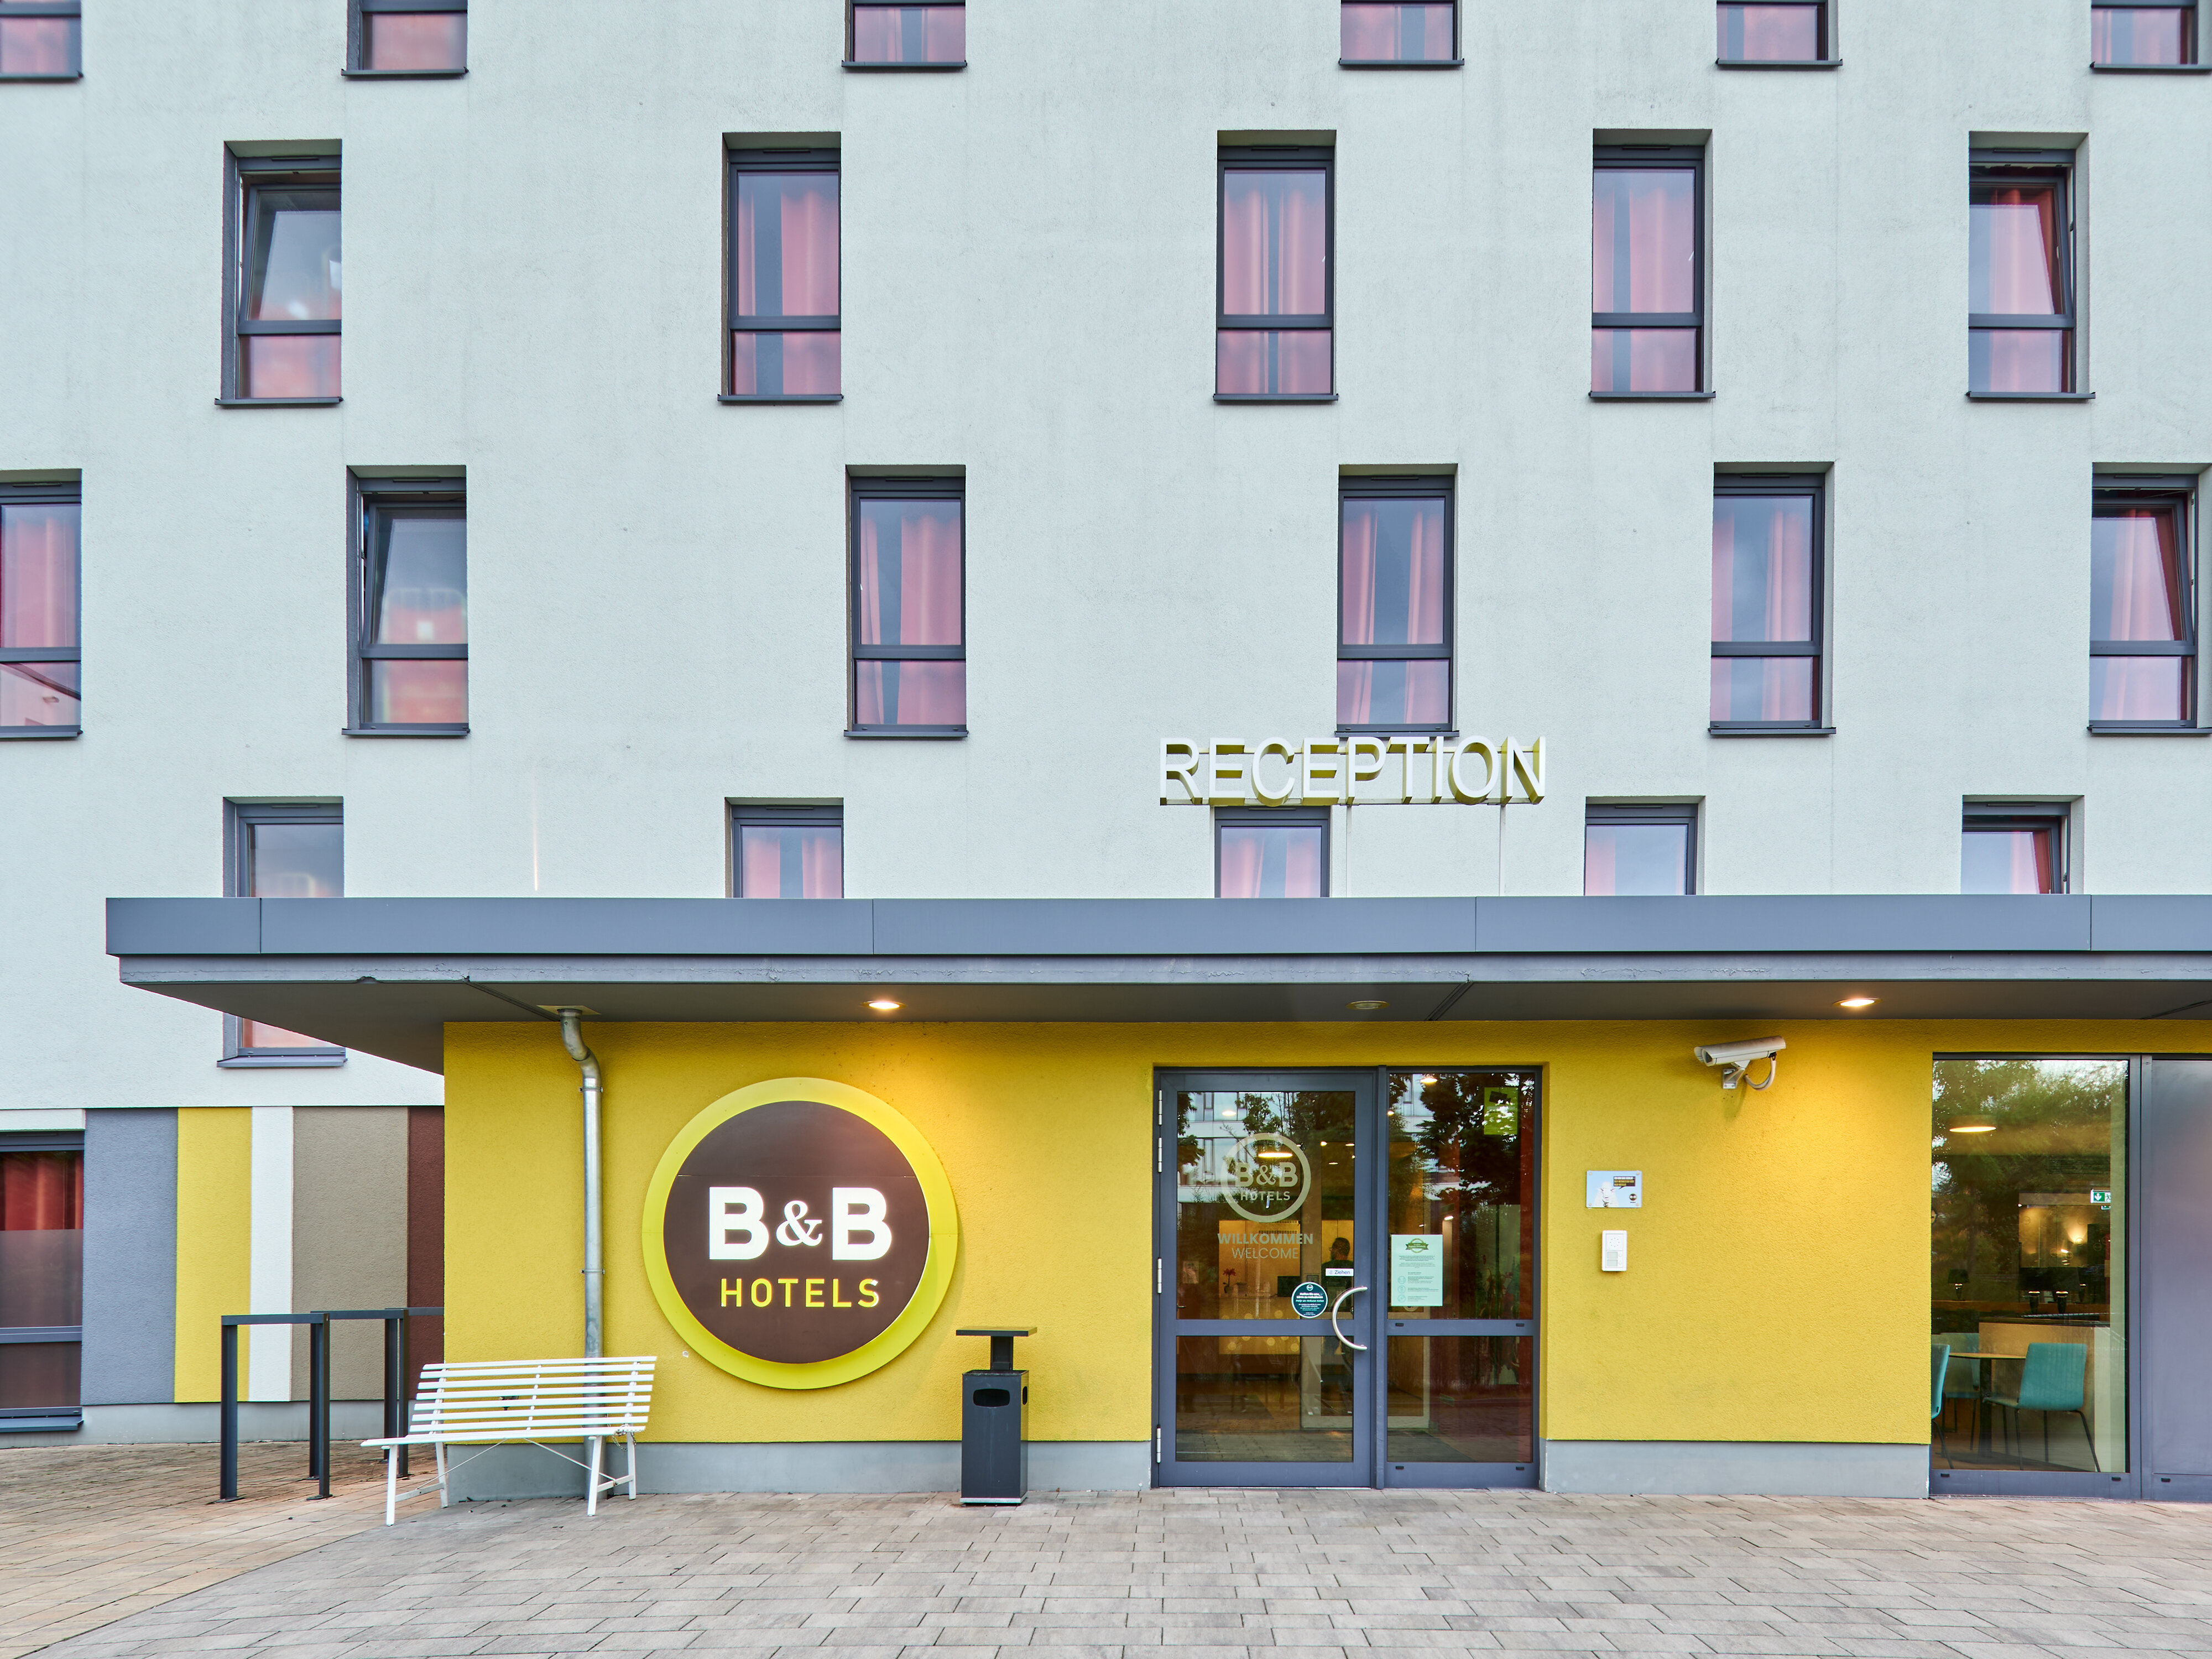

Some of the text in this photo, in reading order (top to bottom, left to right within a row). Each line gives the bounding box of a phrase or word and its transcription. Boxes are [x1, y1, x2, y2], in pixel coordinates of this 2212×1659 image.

[1160, 735, 1546, 806] RECEPTION
[1234, 1162, 1298, 1188] B&B
[1240, 1191, 1291, 1201] HOTELS
[709, 1186, 893, 1261] B&B
[1217, 1233, 1313, 1244] WILLKOMMEN
[1231, 1248, 1299, 1259] WELCOME
[721, 1278, 879, 1307] HOTELS
